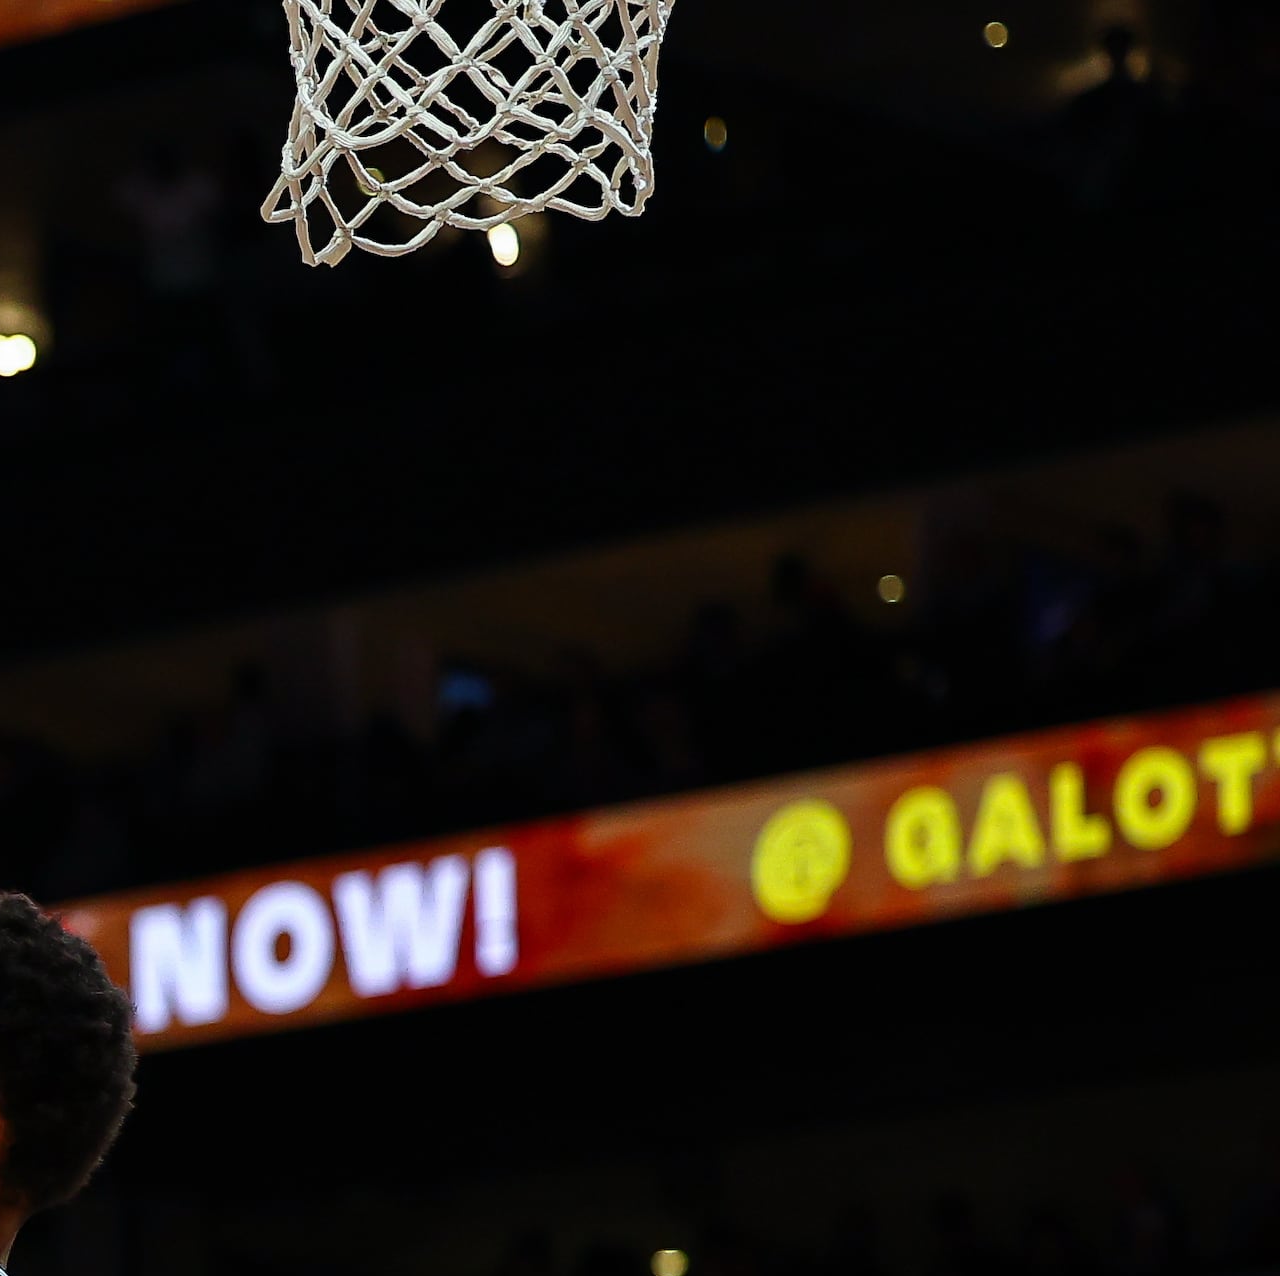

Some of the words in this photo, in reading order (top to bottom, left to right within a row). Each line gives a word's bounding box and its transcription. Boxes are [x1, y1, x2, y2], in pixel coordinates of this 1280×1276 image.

[130, 846, 519, 1033] NOW!
[751, 801, 853, 926] @
[885, 729, 1280, 891] GALOT
